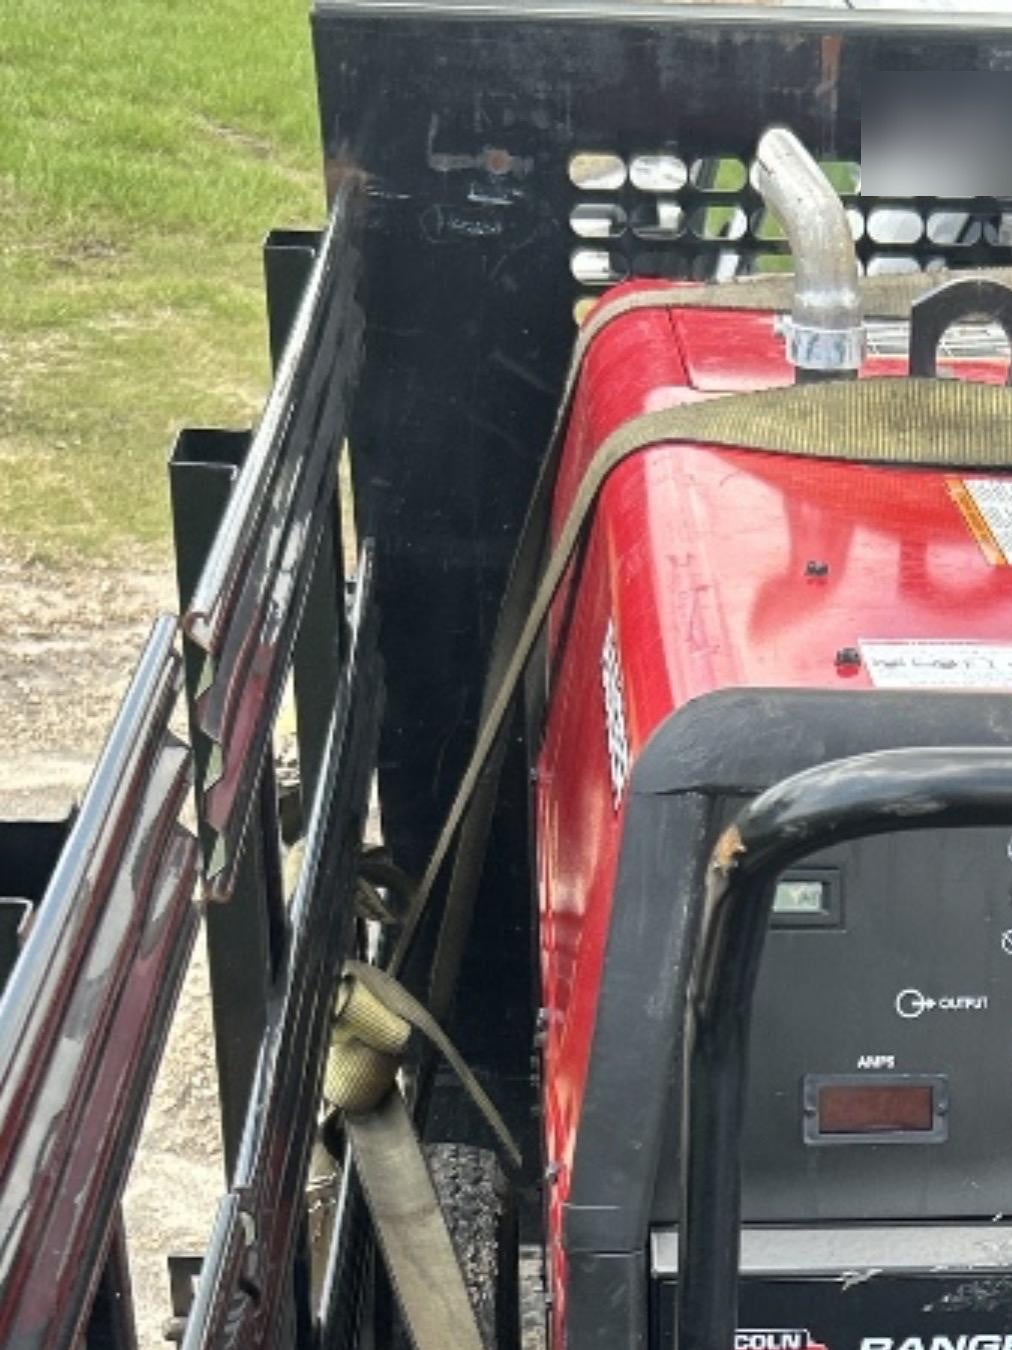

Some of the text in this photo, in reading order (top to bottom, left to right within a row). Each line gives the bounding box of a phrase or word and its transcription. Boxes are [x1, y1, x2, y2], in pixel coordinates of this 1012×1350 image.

[938, 996, 988, 1009] OUTPUT
[857, 1055, 895, 1069] AMPS
[734, 1333, 801, 1350] COLN
